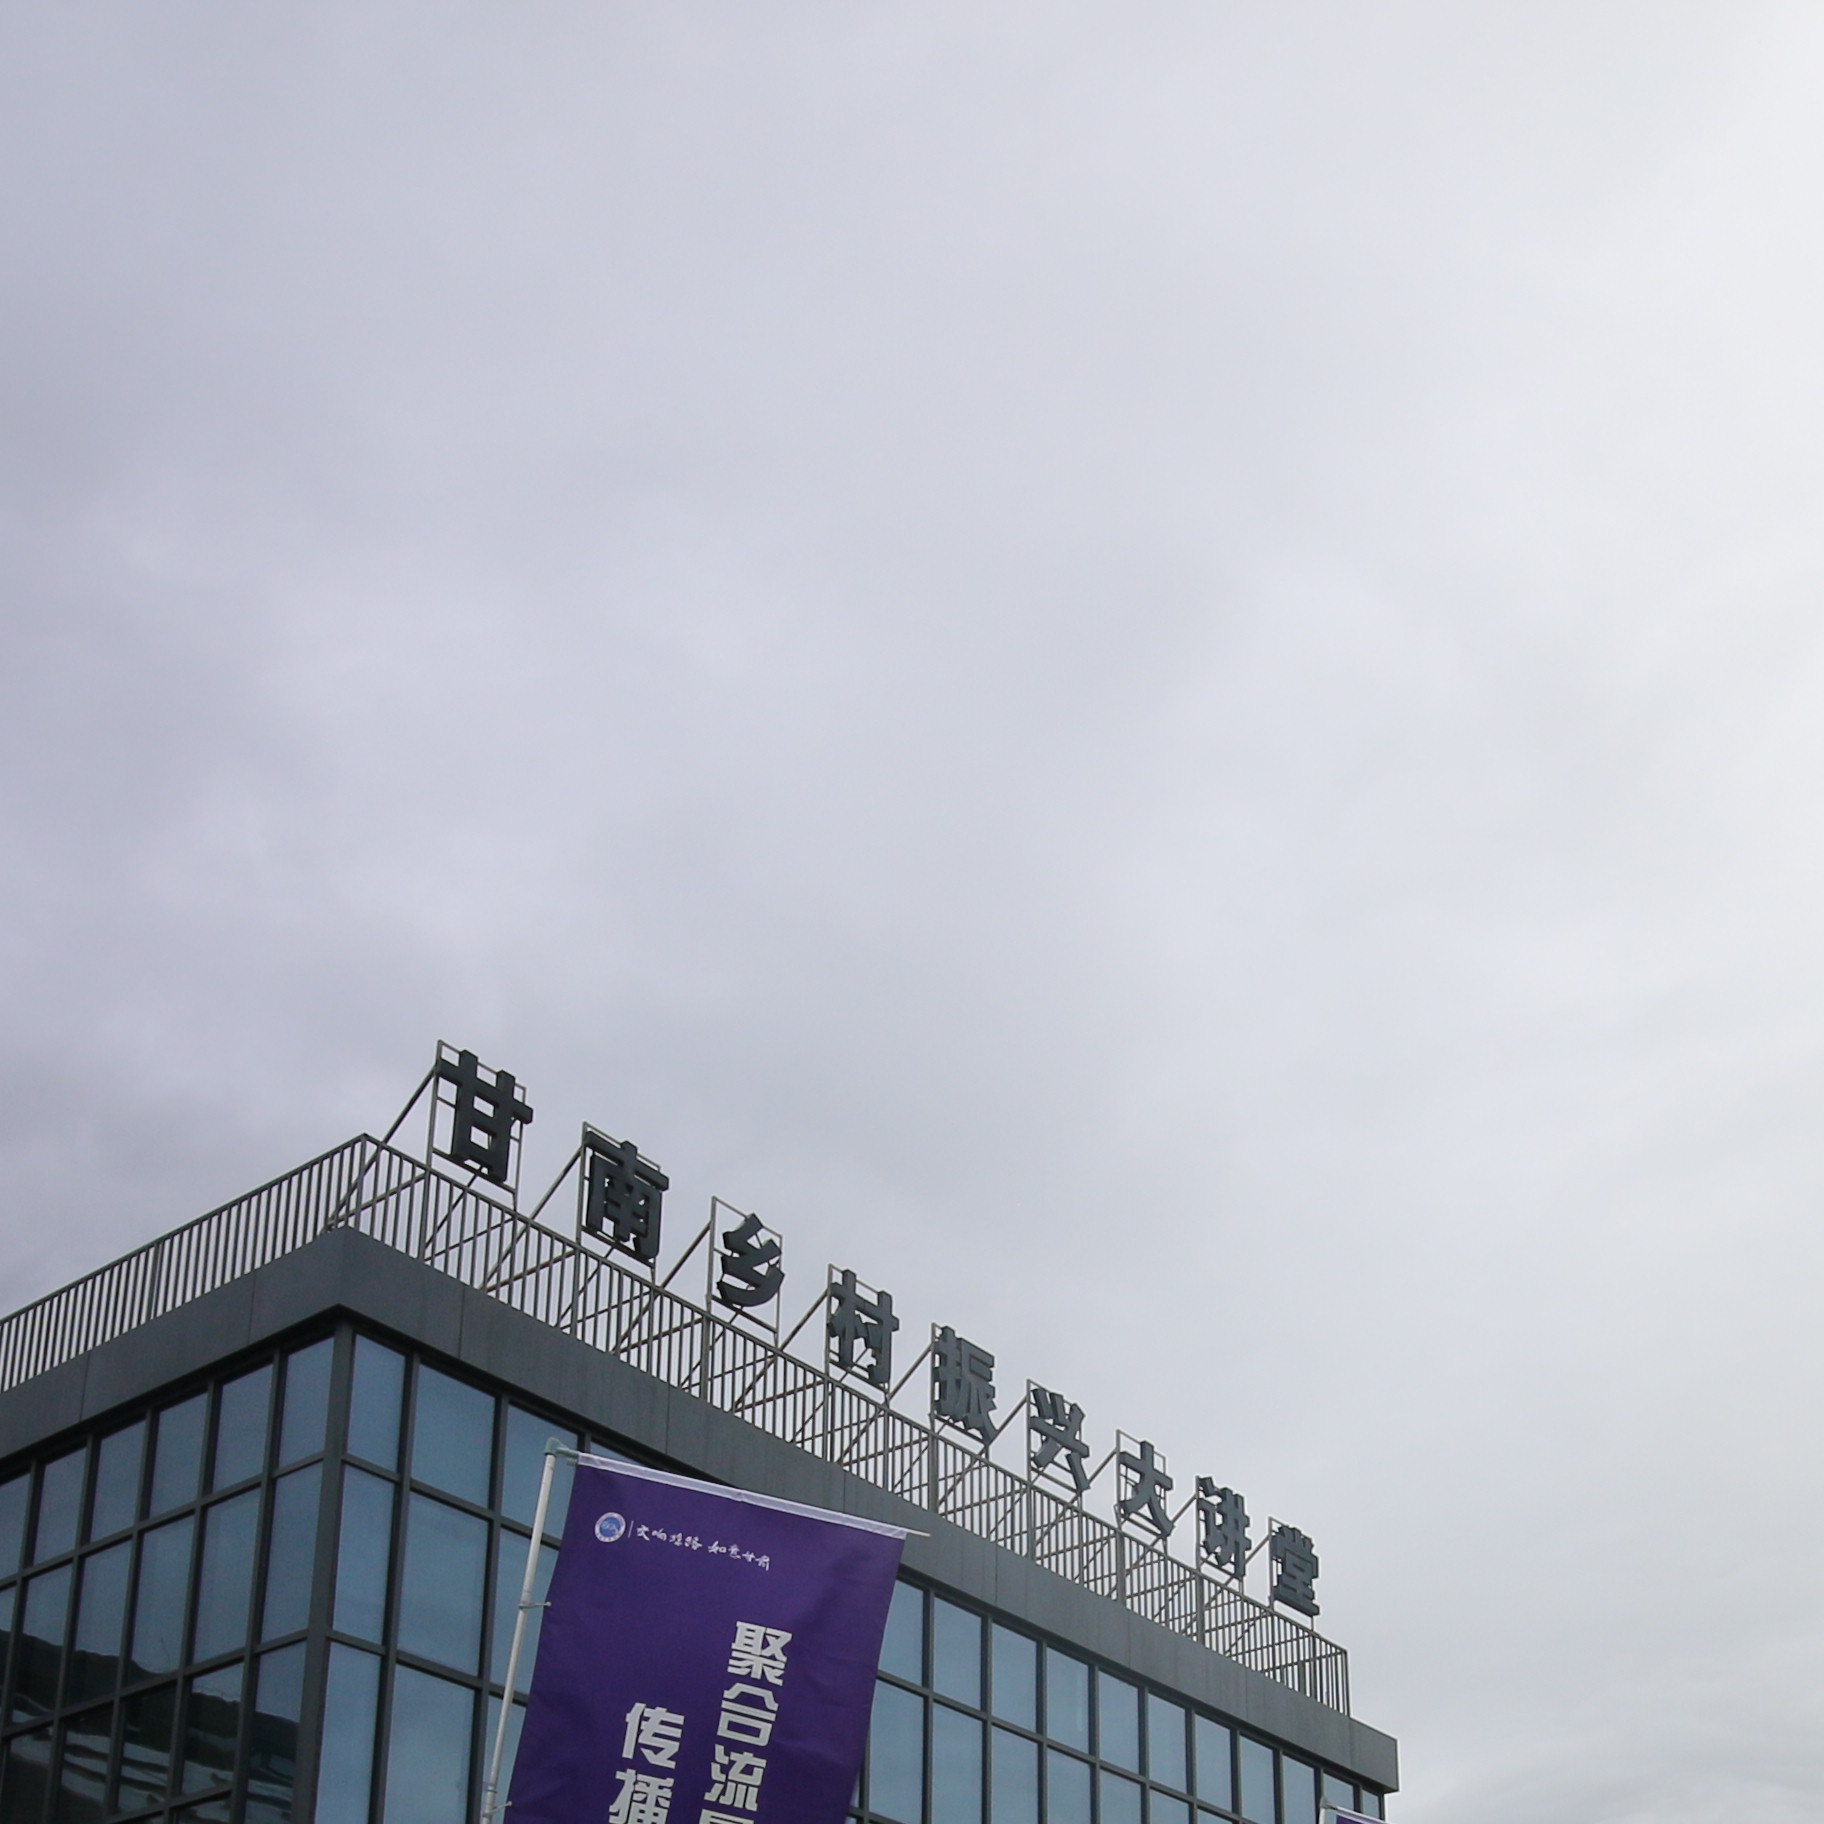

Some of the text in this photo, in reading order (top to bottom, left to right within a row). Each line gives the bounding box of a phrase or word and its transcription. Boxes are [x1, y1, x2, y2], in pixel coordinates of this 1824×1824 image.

[438, 1049, 1319, 1617] 甘南乡村振兴大讲堂
